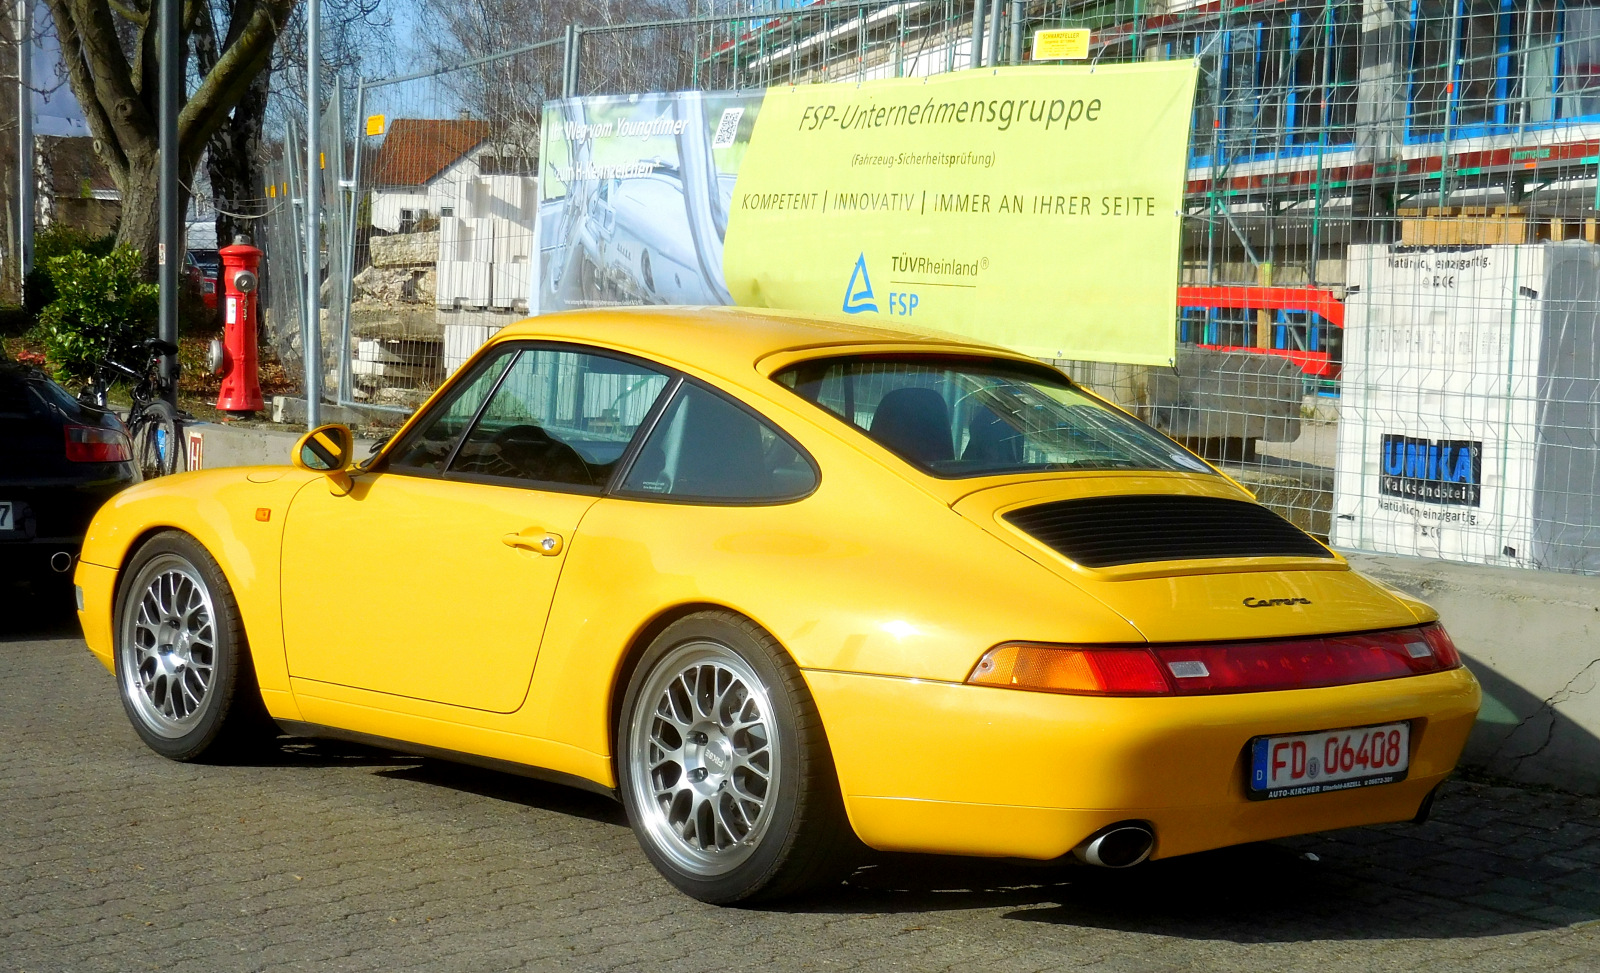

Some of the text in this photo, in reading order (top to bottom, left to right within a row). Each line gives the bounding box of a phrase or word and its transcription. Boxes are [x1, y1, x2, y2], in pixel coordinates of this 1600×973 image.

[798, 97, 1102, 131] FSP-Unternehmensgruppe
[565, 120, 588, 144] Weg
[588, 122, 613, 138] vom
[615, 115, 690, 142] Youngtimer
[851, 151, 996, 168] (Fahrzeug-Sicherheitsprüfung)
[555, 165, 575, 182] zum
[741, 193, 818, 210] KOMPETENT
[833, 193, 915, 211] INNOVATIV
[934, 193, 991, 213] IMMER
[998, 194, 1024, 214] AN
[1033, 195, 1091, 216] IHRER
[1101, 196, 1155, 217] SEITE
[889, 292, 920, 316] FSP
[1383, 478, 1475, 501] Kalksandstein
[1242, 596, 1313, 609] Carrera
[1256, 729, 1401, 781] D FD 06408
[1268, 785, 1320, 799] AUTO-KIRCHER
